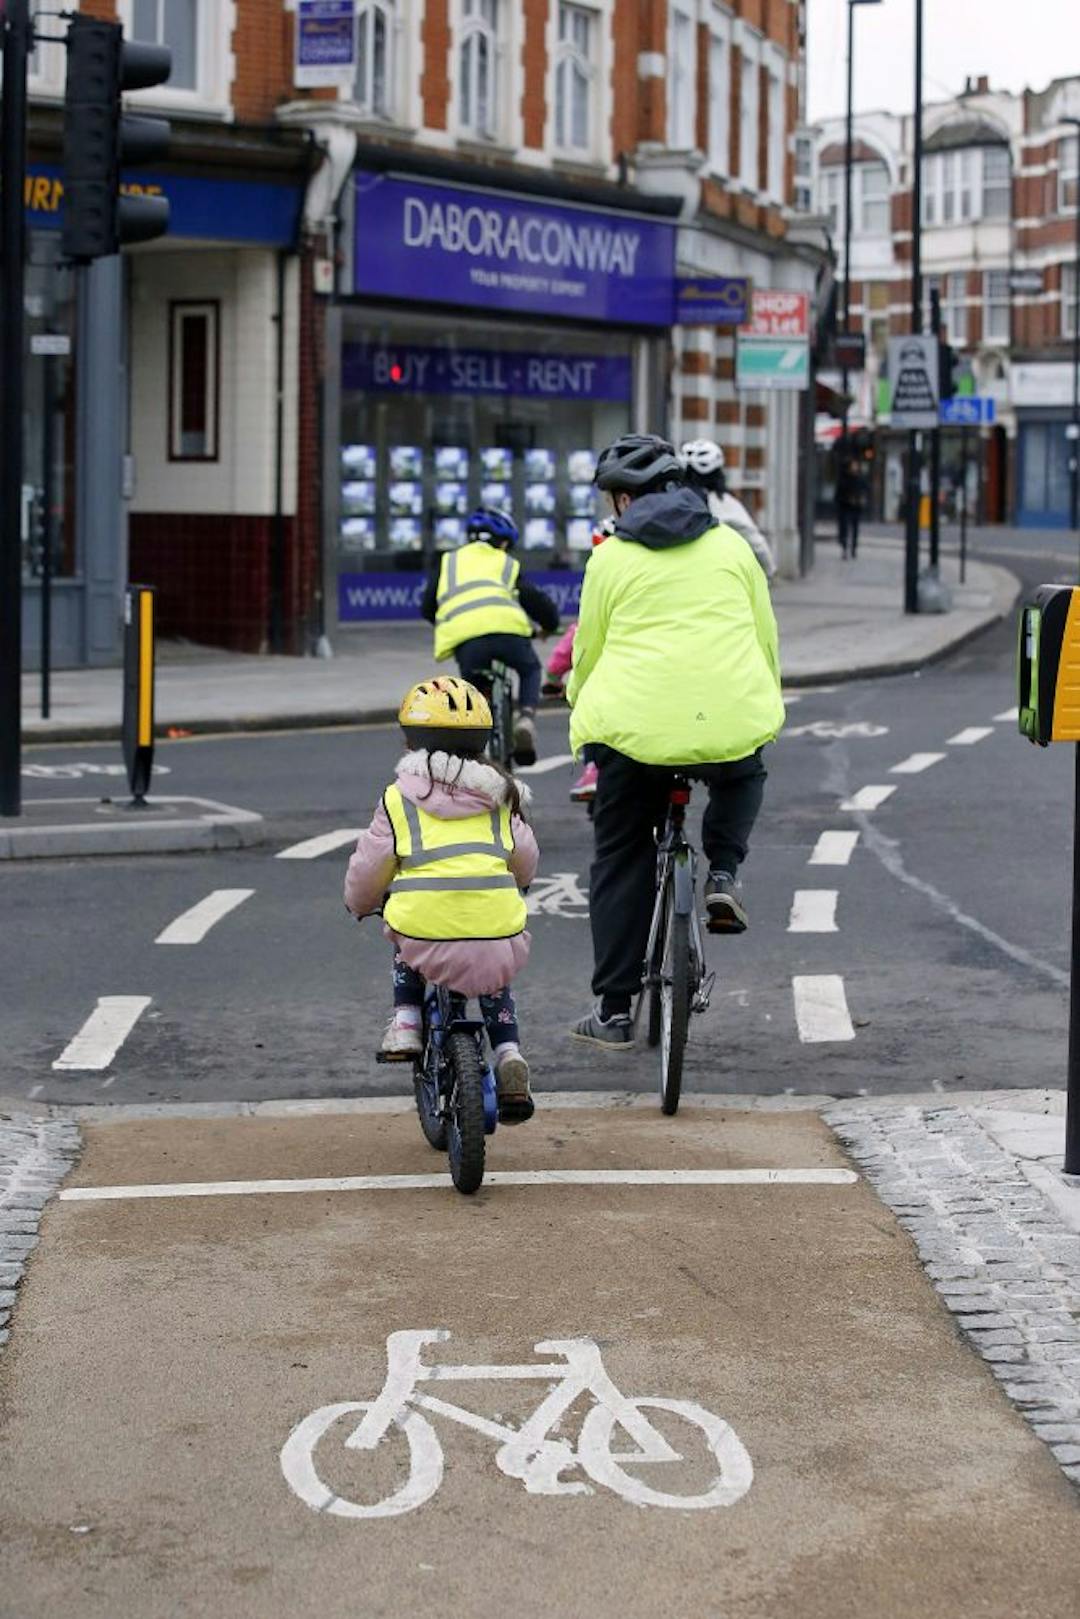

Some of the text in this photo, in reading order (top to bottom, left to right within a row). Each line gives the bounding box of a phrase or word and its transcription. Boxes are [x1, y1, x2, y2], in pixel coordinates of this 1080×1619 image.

[403, 198, 640, 277] DABORACONWAY
[373, 351, 597, 392] BUY SELL RENT
